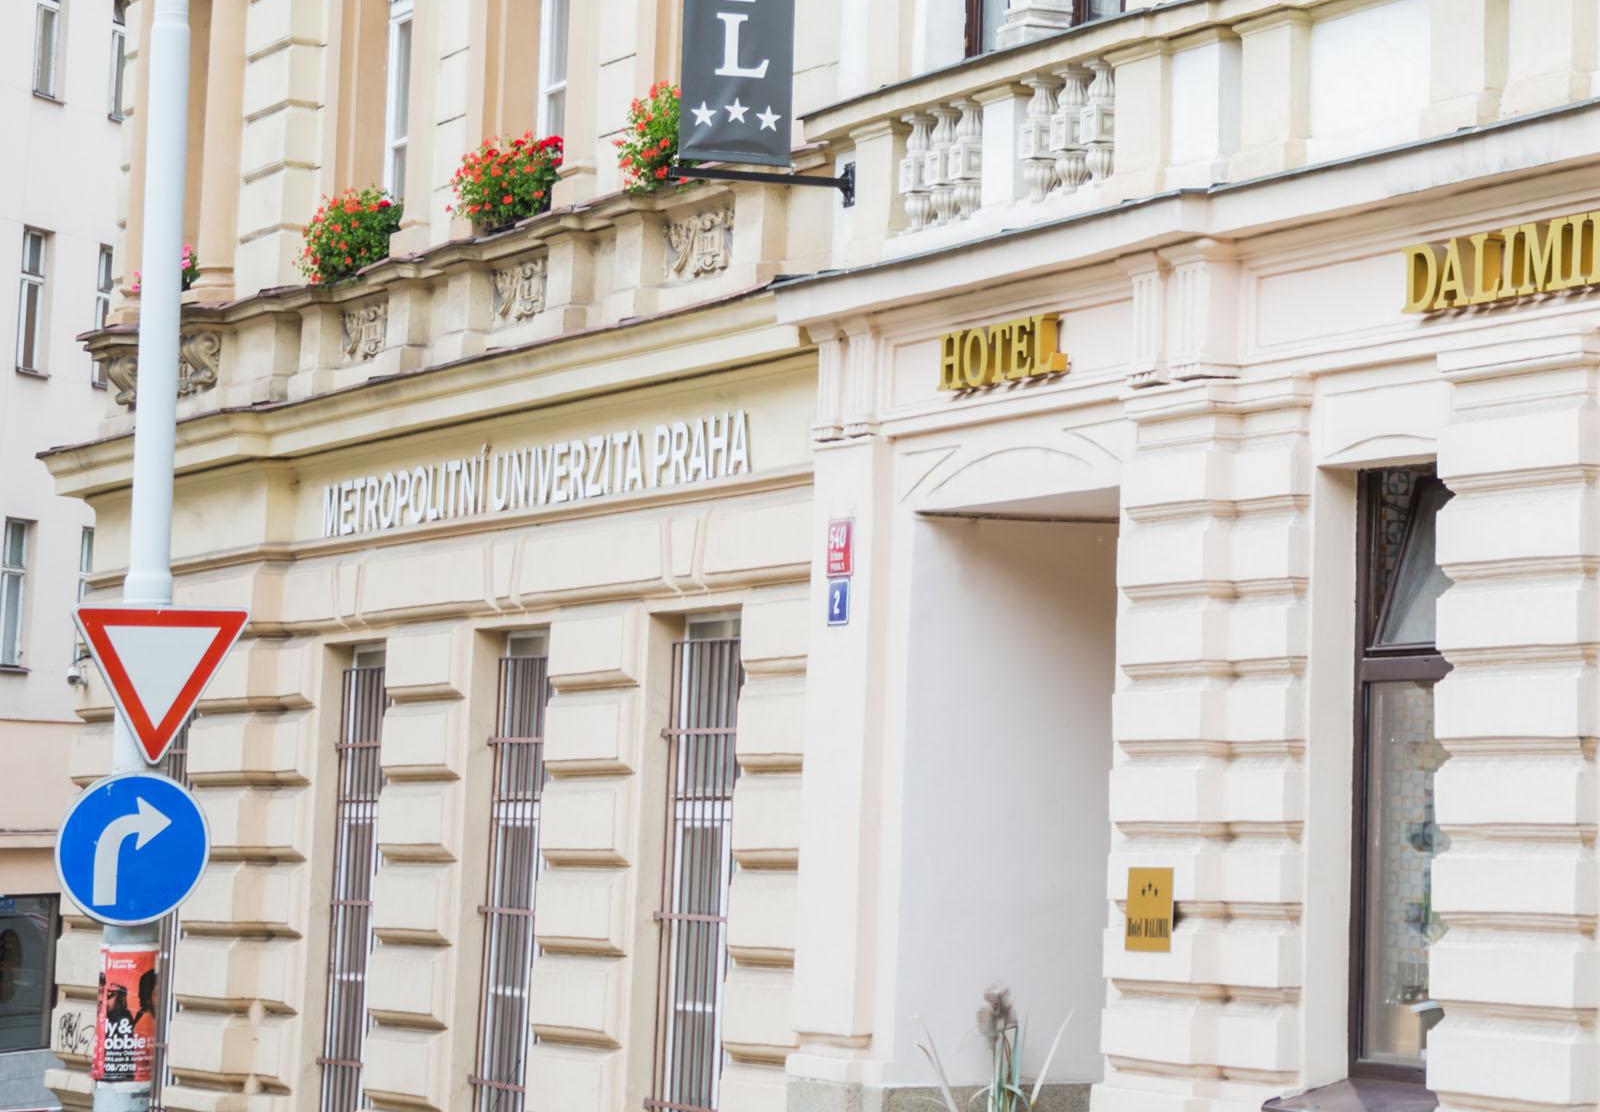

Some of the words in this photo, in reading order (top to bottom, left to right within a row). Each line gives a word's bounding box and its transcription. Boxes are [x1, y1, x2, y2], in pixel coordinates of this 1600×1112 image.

[937, 313, 1068, 392] HOTEL
[322, 440, 494, 538] METROPOLITNÍ
[491, 428, 644, 512] UNIVERZITA
[650, 408, 752, 488] PRAHA
[833, 590, 841, 616] 2
[104, 1063, 137, 1072] 08/2018
